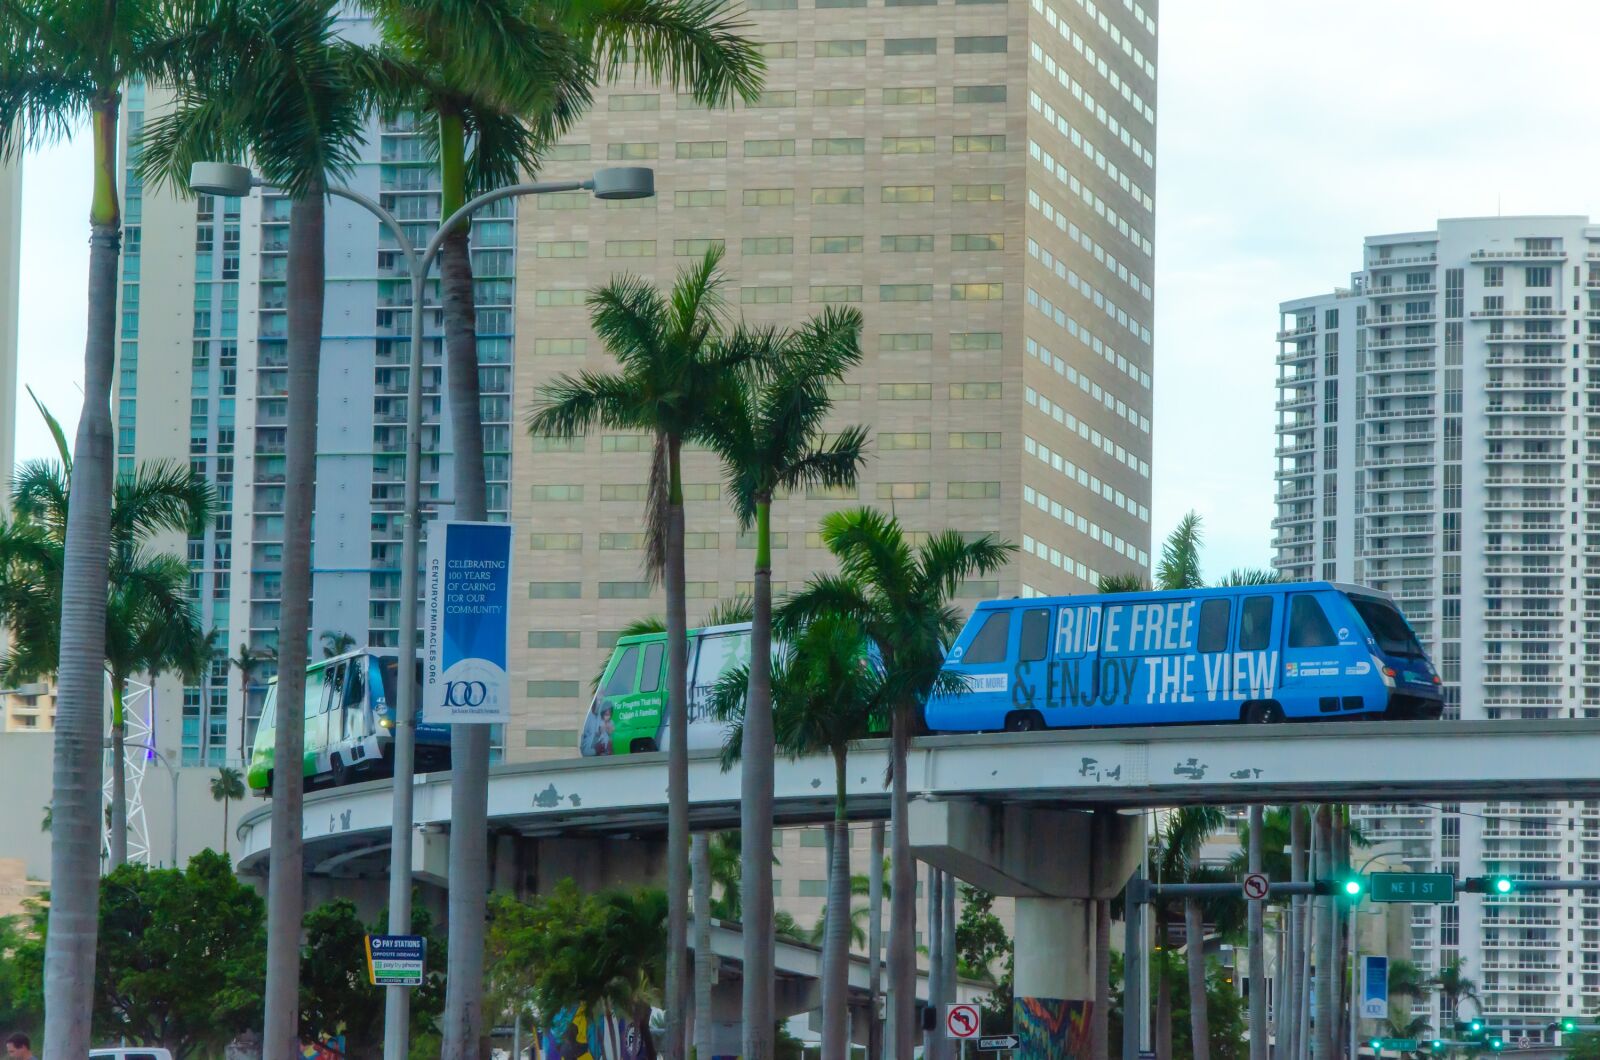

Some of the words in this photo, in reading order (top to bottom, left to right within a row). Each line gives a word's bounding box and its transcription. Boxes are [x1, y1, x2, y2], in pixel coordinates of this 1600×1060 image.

[447, 560, 505, 569] CELEBRATING
[448, 571, 462, 580] 100
[464, 571, 491, 580] YEARS
[447, 582, 459, 591] OF
[461, 582, 496, 591] CARING
[447, 594, 464, 603] FOR
[466, 594, 485, 603] OUR
[446, 605, 502, 614] COMMUNITY
[428, 558, 439, 684] CENTURYOFMIRACLES.ORG
[1055, 605, 1123, 654] RIDE
[1128, 600, 1196, 651] FREE
[985, 677, 1005, 689] MORE
[1012, 661, 1036, 709] &
[1045, 658, 1138, 708] ENJOY
[1144, 654, 1196, 704] THE
[1203, 650, 1278, 702] VIEW
[440, 680, 487, 707] 100
[1391, 882, 1404, 893] NE
[1422, 882, 1435, 893] ST
[382, 940, 393, 948] PAY
[394, 940, 420, 948] STATIONS
[995, 1039, 1008, 1047] WAY
